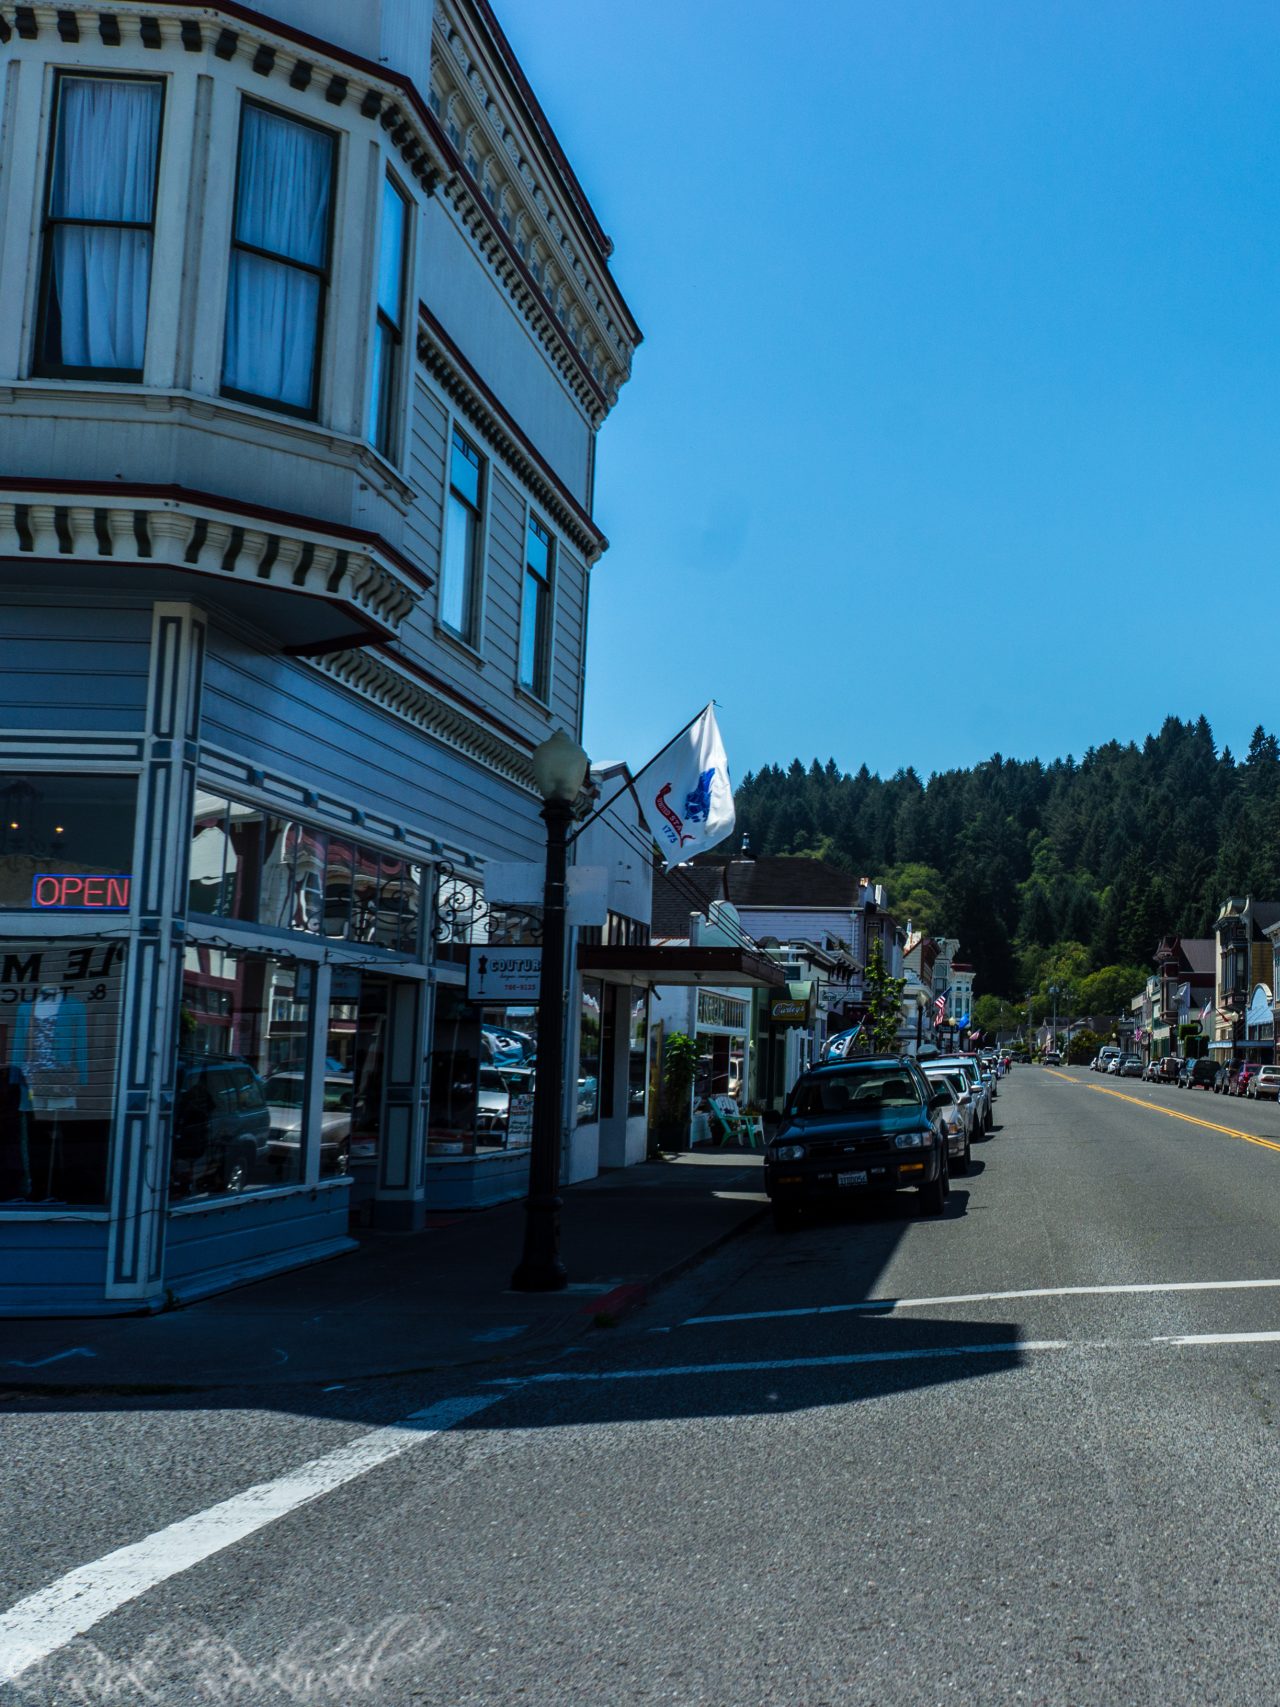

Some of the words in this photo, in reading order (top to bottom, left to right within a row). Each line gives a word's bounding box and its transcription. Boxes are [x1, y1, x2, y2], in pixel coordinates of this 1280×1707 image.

[670, 815, 682, 831] STA
[662, 824, 678, 844] 1775
[36, 877, 129, 906] OPEN
[490, 959, 542, 973] COUTUR
